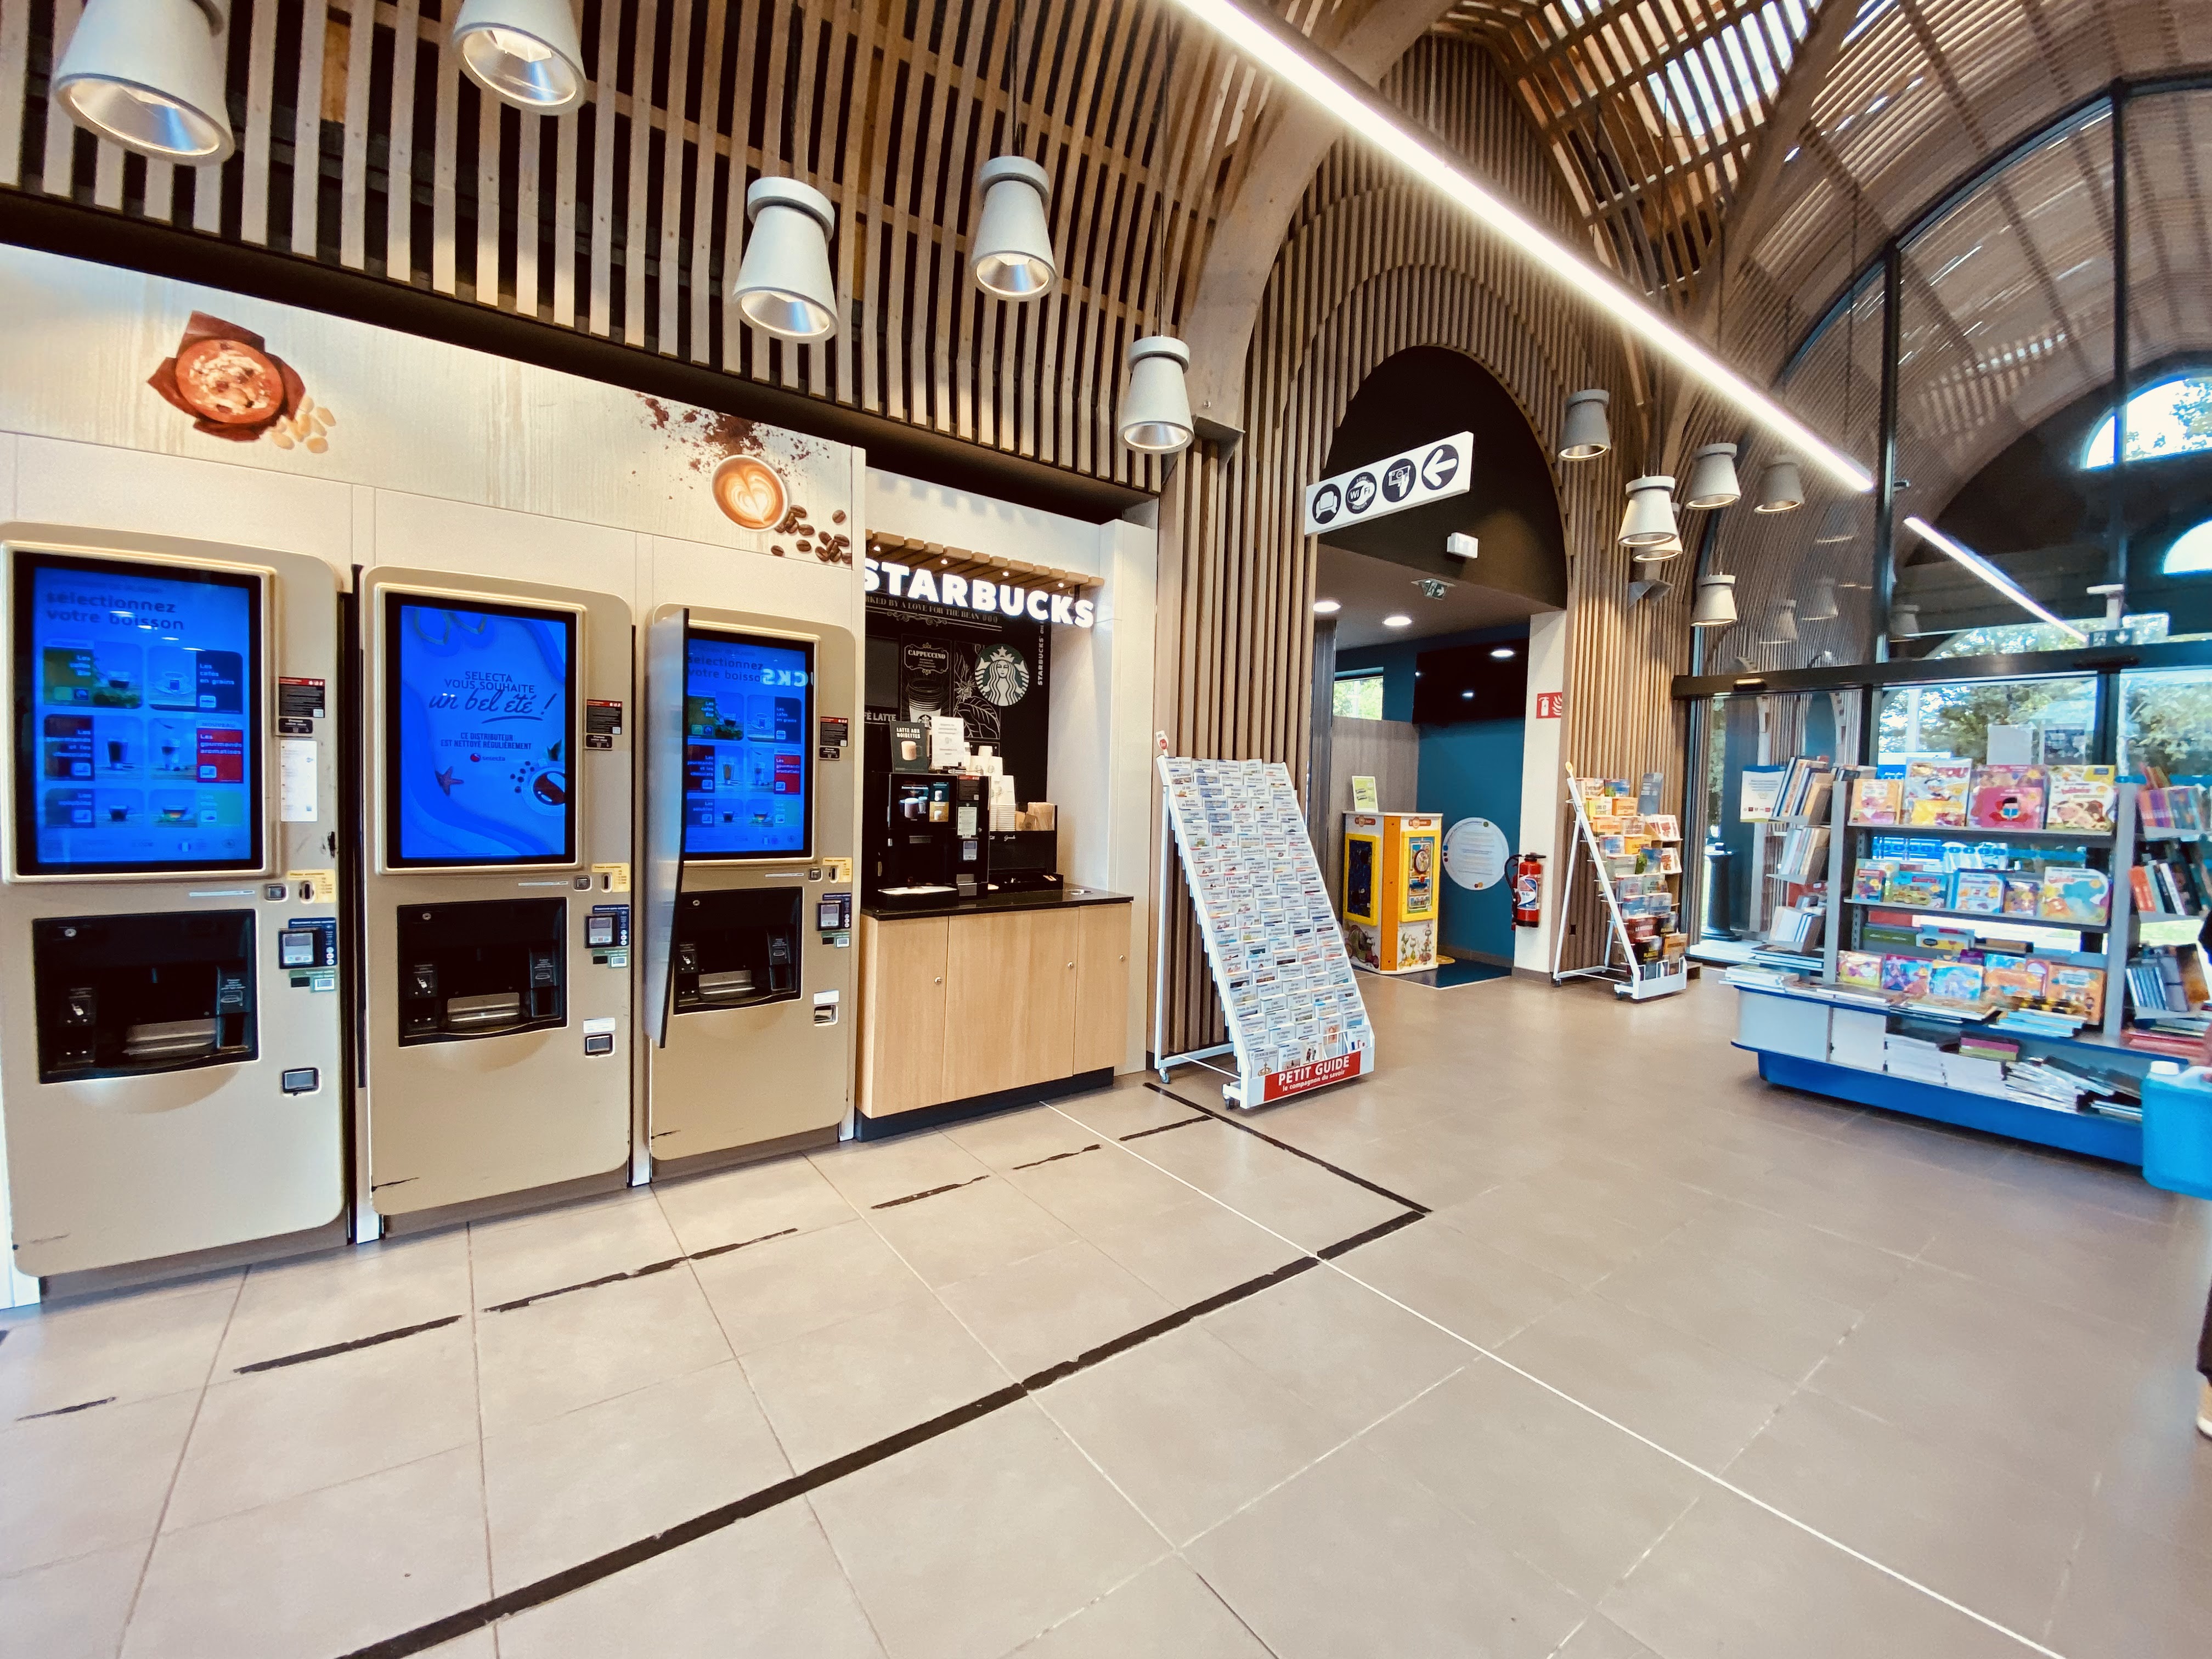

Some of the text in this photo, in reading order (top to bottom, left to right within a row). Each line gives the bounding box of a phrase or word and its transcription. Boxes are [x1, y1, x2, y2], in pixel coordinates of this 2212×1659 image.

[865, 557, 1094, 628] STARBUCKS
[908, 650, 946, 659] CAPPUCCINO
[465, 670, 513, 683] SELECTA
[724, 670, 761, 683] boisso
[444, 678, 535, 693] VOUS SOUHAITE
[465, 688, 504, 712] bel
[873, 712, 897, 722] LATTE
[441, 739, 453, 747] EST
[460, 732, 514, 742] CE DISTRIBUTEUR
[1278, 1056, 1350, 1086] PETIT GUIDE
[1289, 1077, 1321, 1090] compagnon
[1329, 1070, 1346, 1079] savoir
